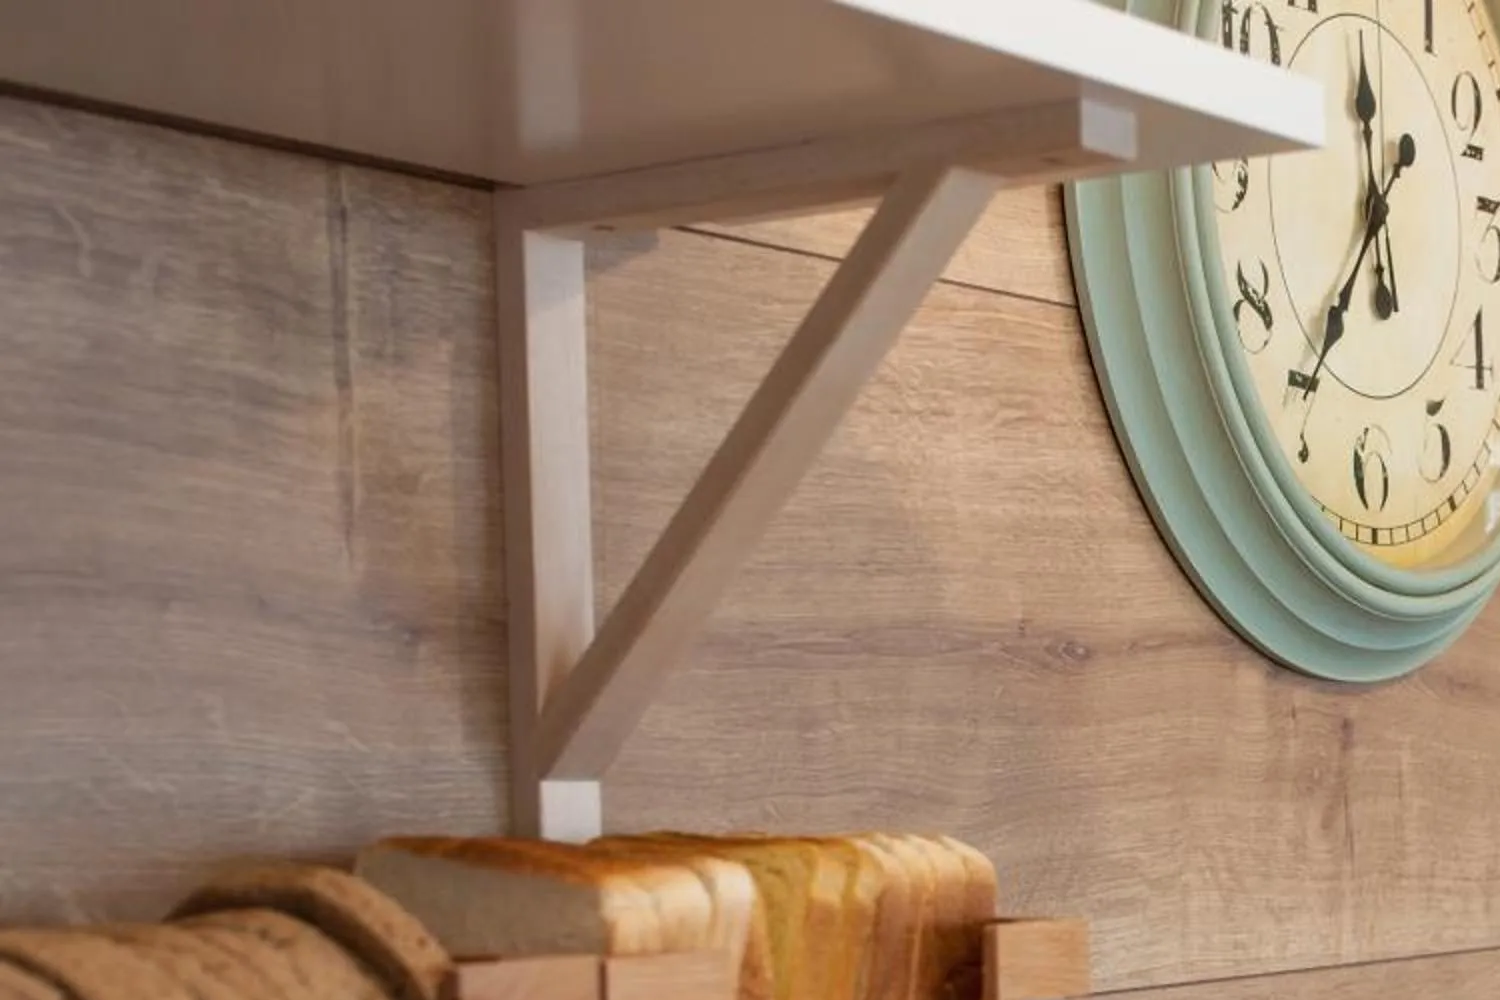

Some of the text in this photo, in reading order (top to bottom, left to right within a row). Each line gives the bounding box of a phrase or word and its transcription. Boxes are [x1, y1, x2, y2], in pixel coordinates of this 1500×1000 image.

[1451, 71, 1485, 162] 2
[1233, 256, 1273, 355] 8
[1450, 304, 1494, 391] 4
[1282, 369, 1320, 464] 7
[1417, 397, 1450, 483] 5
[1353, 423, 1392, 511] 6
